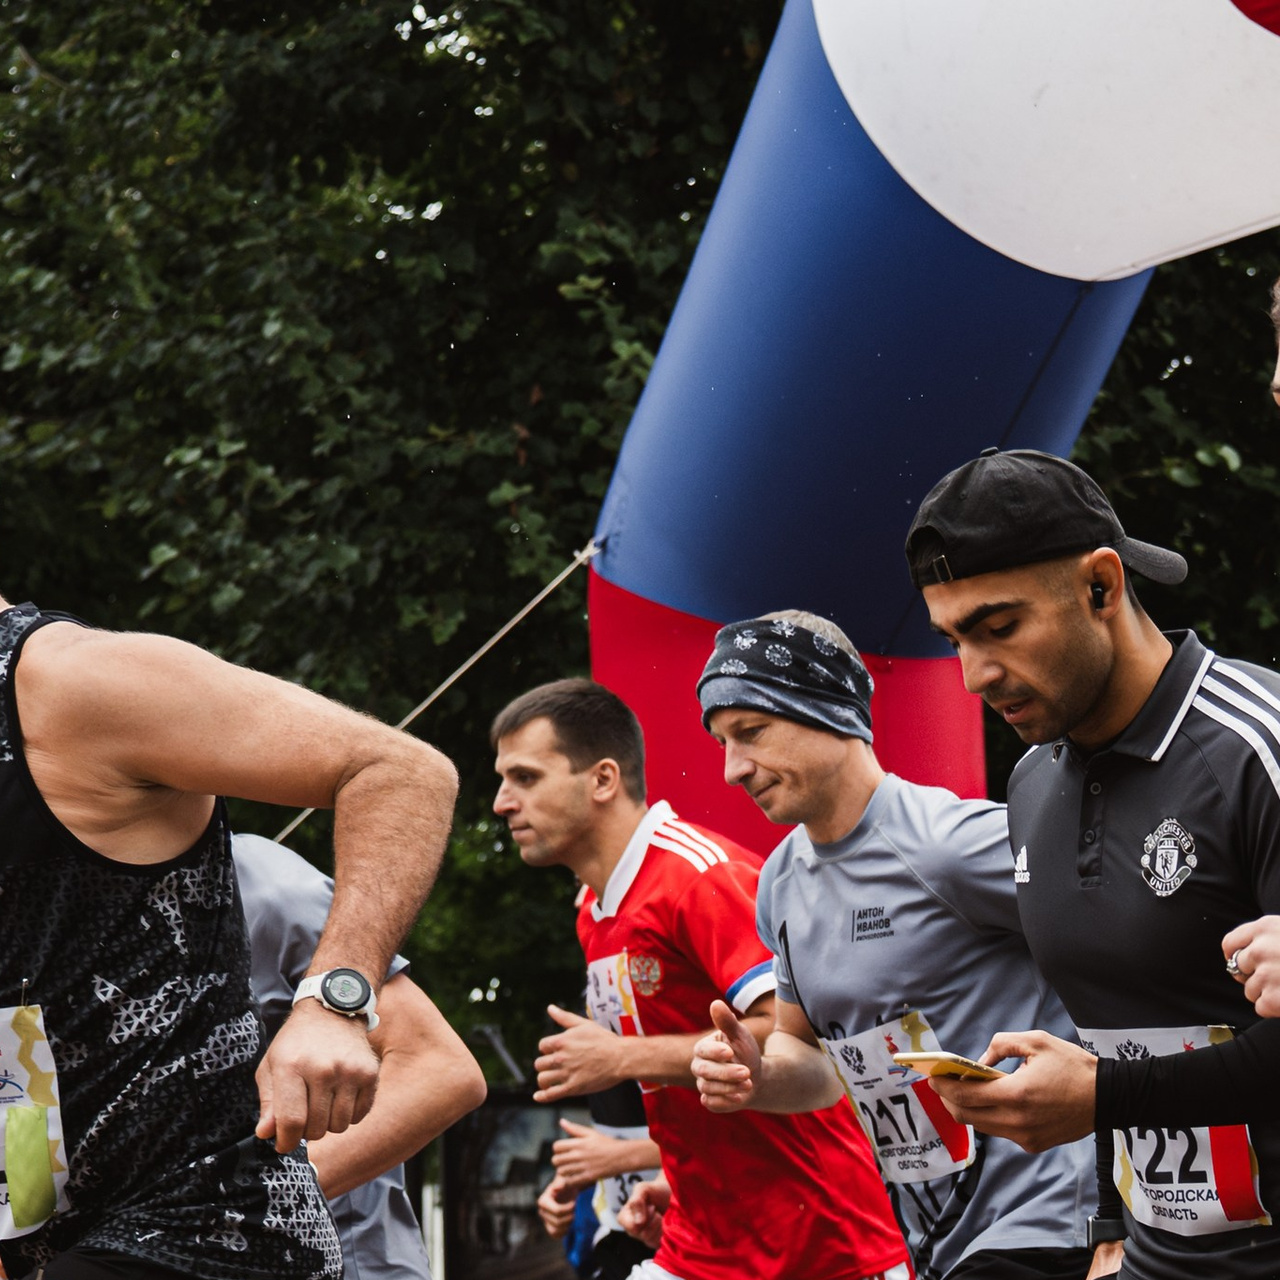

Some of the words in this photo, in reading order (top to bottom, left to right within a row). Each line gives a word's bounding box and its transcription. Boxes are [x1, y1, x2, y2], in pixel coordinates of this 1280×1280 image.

[1150, 876, 1181, 891] UNITED
[857, 906, 885, 920] АНТОН
[856, 918, 891, 933] ИВАНОВ
[859, 1093, 919, 1147] 217
[1151, 1204, 1199, 1221] ОБЛАСТЬ
